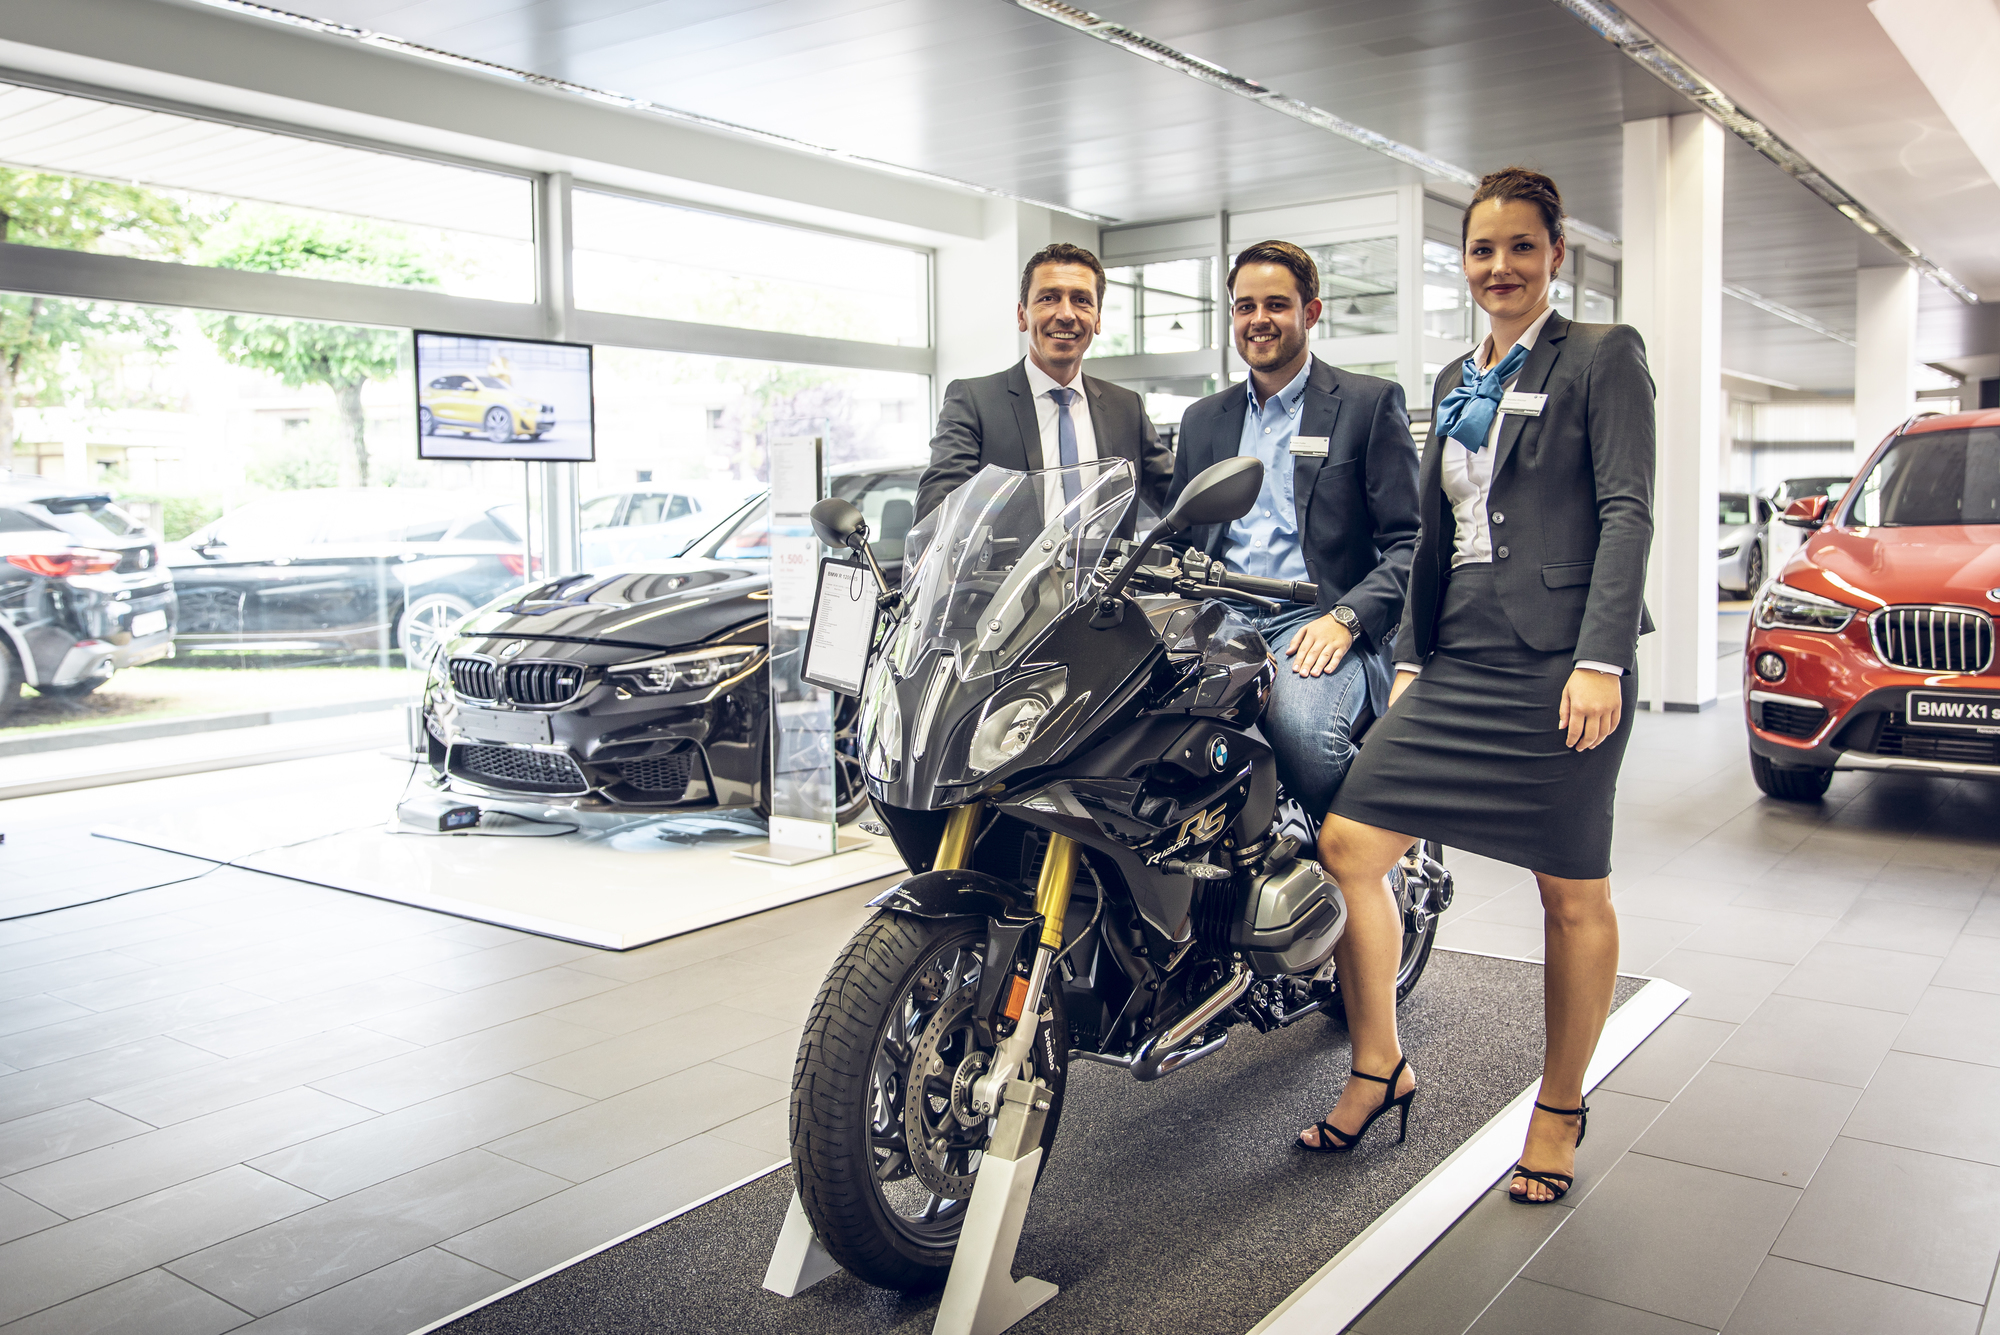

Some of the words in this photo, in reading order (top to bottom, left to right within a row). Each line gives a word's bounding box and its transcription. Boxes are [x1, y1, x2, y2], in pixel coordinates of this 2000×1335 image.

[1917, 701, 1965, 718] BMW
[1966, 703, 1988, 719] X1
[1176, 802, 1228, 842] RS
[1044, 1028, 1055, 1070] brembo
